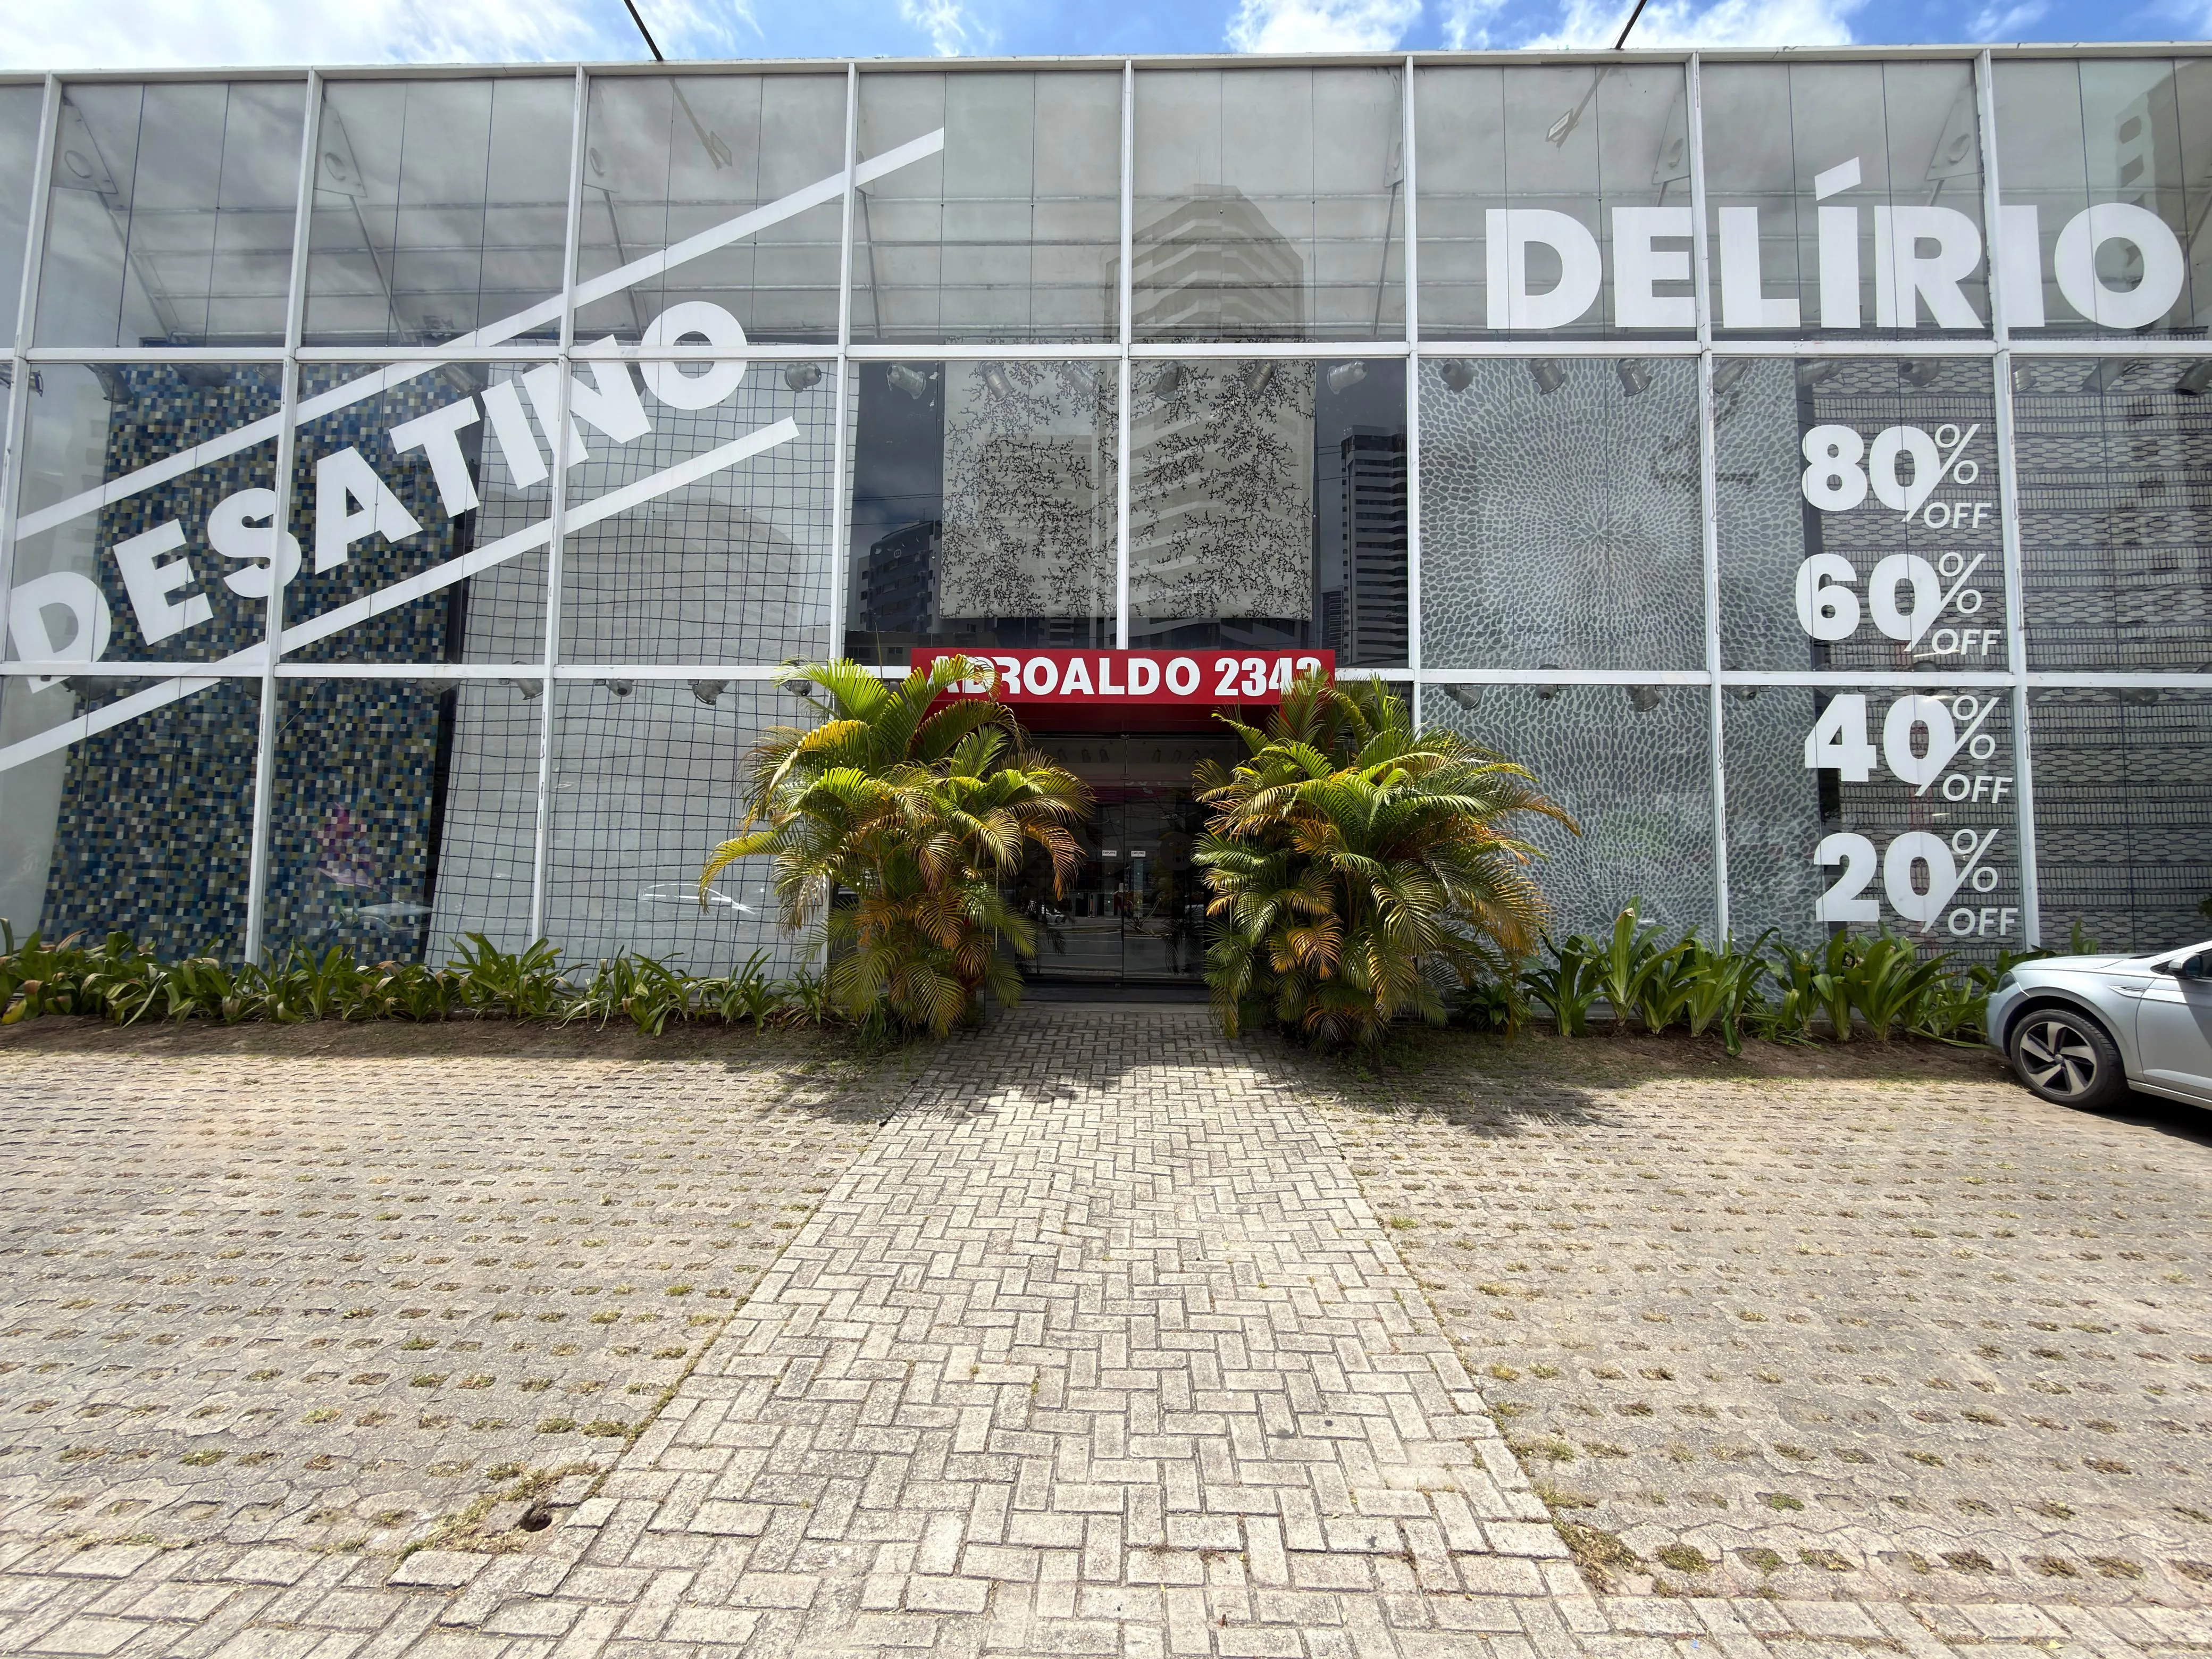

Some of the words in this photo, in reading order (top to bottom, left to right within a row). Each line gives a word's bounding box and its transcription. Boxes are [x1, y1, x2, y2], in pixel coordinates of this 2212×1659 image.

[1485, 156, 2184, 330] DELÍRIO
[8, 300, 748, 694] DESATINO
[1801, 423, 1981, 522] 80%
[1923, 502, 1991, 529] OFF
[1795, 552, 1987, 652] 60%
[1931, 629, 2000, 656] OFF
[1805, 694, 2000, 797] 40%
[1942, 774, 2013, 803] OFF
[1814, 828, 1999, 933] 20%
[1948, 907, 2018, 936] OFF
